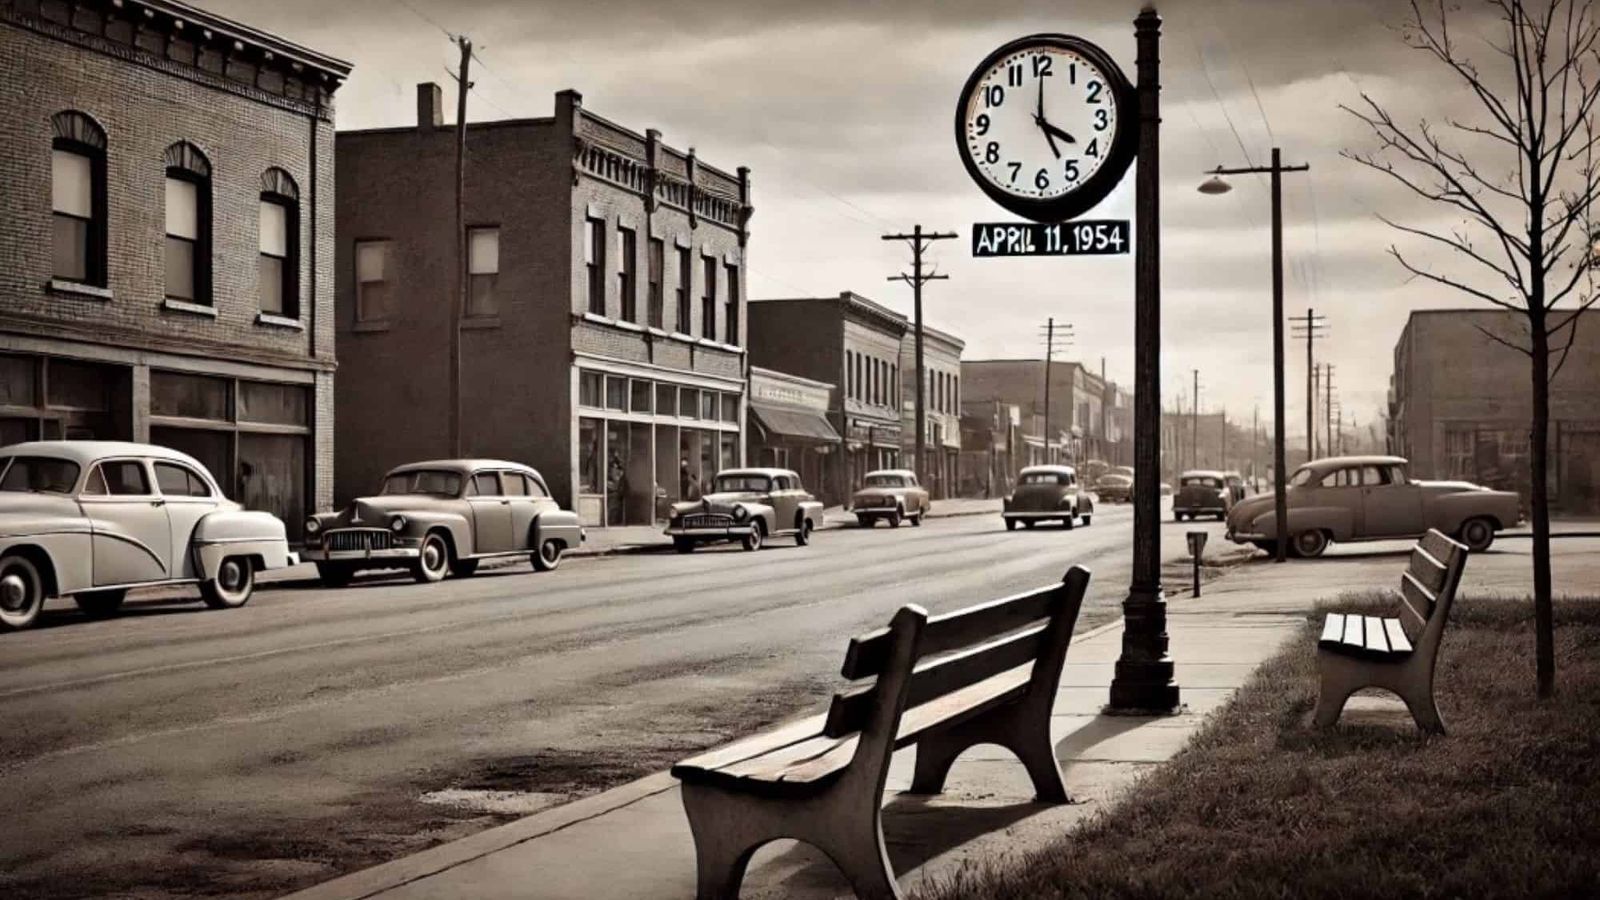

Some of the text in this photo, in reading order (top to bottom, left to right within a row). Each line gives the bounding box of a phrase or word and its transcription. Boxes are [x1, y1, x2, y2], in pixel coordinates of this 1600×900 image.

[1008, 64, 1023, 87] 11
[1032, 55, 1053, 78] 12
[1069, 63, 1076, 85] 1
[984, 85, 1005, 109] 10
[1086, 80, 1103, 104] 2
[975, 113, 991, 136] 9
[1093, 108, 1108, 132] 3
[985, 141, 1000, 165] 8
[1084, 137, 1099, 158] 4
[1007, 162, 1022, 183] 7
[1034, 168, 1050, 191] 6
[1064, 159, 1080, 183] 5
[976, 225, 1036, 254] APRIL
[1073, 224, 1125, 252] 1954
